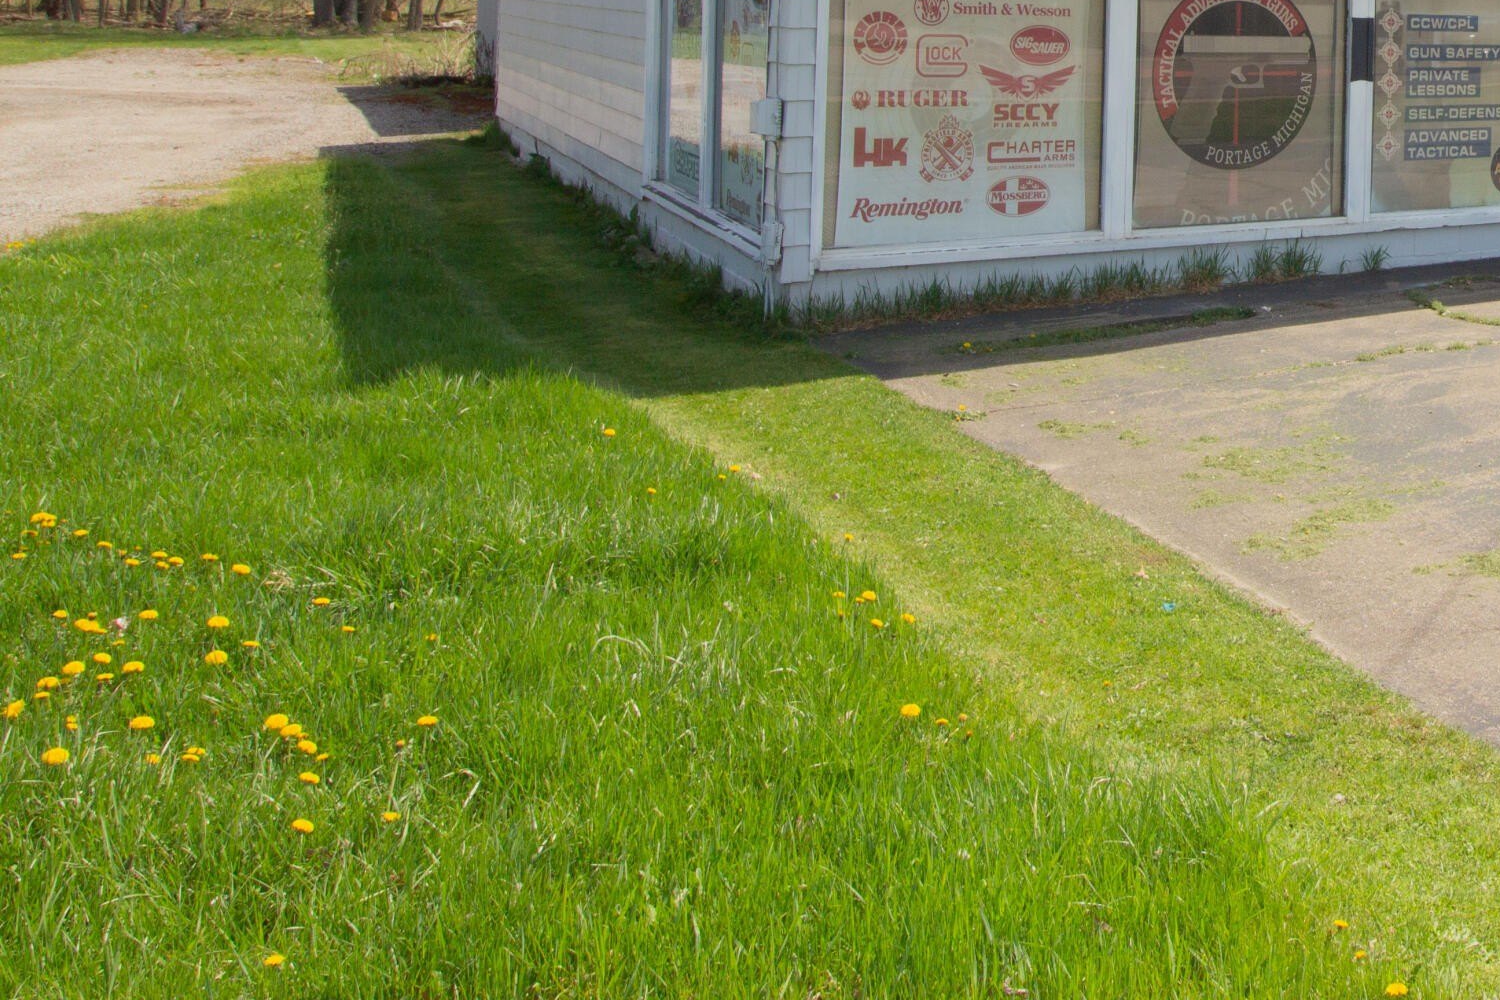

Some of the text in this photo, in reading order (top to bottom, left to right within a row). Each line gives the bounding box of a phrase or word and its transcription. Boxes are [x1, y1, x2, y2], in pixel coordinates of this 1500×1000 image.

[953, 2, 1071, 17] Smith & Wesson
[1410, 16, 1475, 30] CCW/CPL
[1015, 36, 1065, 54] SIG SAUER
[1409, 47, 1500, 59] GUN SAFETY
[1162, 27, 1184, 109] TACTICAL
[1409, 70, 1469, 82] PRIVATE
[1409, 84, 1477, 96] LESSONS
[876, 89, 969, 108] RUGER
[994, 104, 1059, 121] SCCY
[1205, 71, 1313, 165] PORTAGE MICHIGAN
[1408, 129, 1488, 143] ADVANCED
[853, 127, 909, 167] HK
[987, 140, 1075, 163] CHARTER
[1408, 146, 1477, 158] TACTICAL
[1044, 153, 1075, 161] ARMS
[991, 191, 1047, 202] MOSSBERG
[850, 197, 964, 223] Remington
